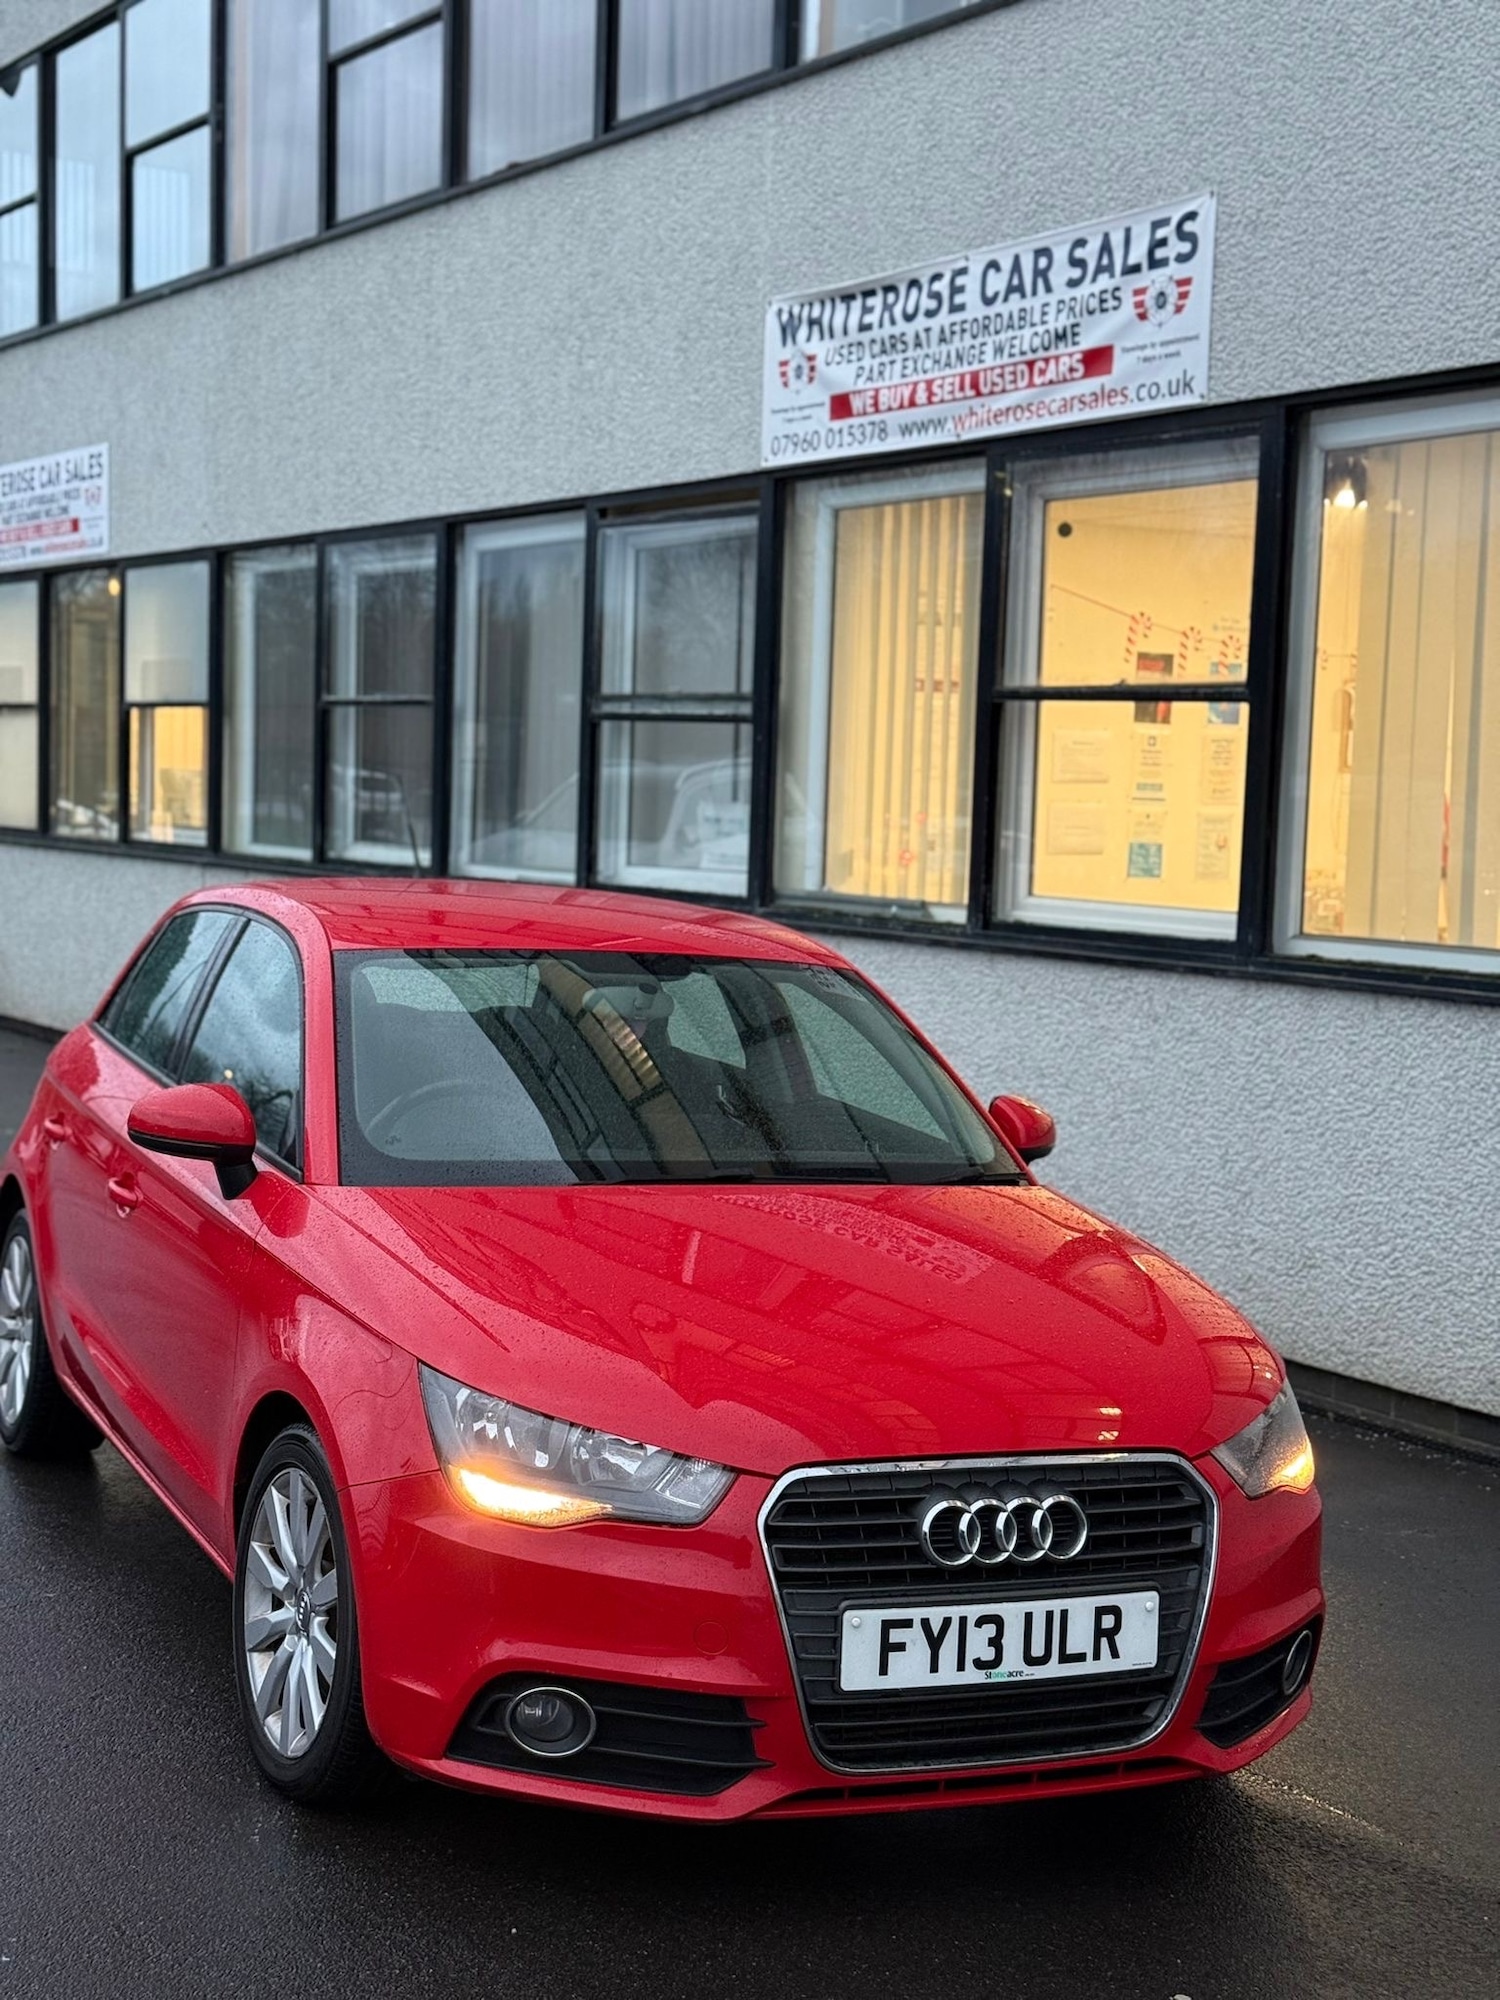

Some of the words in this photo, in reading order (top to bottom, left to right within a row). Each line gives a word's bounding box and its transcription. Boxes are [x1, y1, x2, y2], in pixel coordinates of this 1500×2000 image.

[777, 266, 969, 347] WHITEROSE
[981, 247, 1054, 307] CAR
[1065, 210, 1200, 289] SALES
[824, 341, 866, 367] USED
[870, 332, 909, 358] CARS
[913, 327, 933, 350] AT
[938, 303, 1051, 345] AFFORDABLE
[1055, 287, 1123, 323] PRICES
[853, 361, 895, 386] PART
[900, 341, 987, 379] EXCHANGE
[992, 323, 1082, 363] WELCOME
[771, 429, 821, 457] 07960
[825, 420, 888, 450] 015378
[898, 370, 1196, 439] www.whiterosecarsales.co.uk
[849, 390, 876, 416] WE
[879, 383, 913, 411] BUY
[915, 383, 929, 405] &
[932, 376, 975, 403] SELL
[979, 361, 1028, 394] USED
[1033, 353, 1085, 386] CARS
[39, 461, 61, 489] CAR
[65, 452, 103, 484] SALES
[878, 1613, 1005, 1677] FY13
[1022, 1604, 1123, 1668] ULR
[984, 1669, 1024, 1680] Stoneacre
